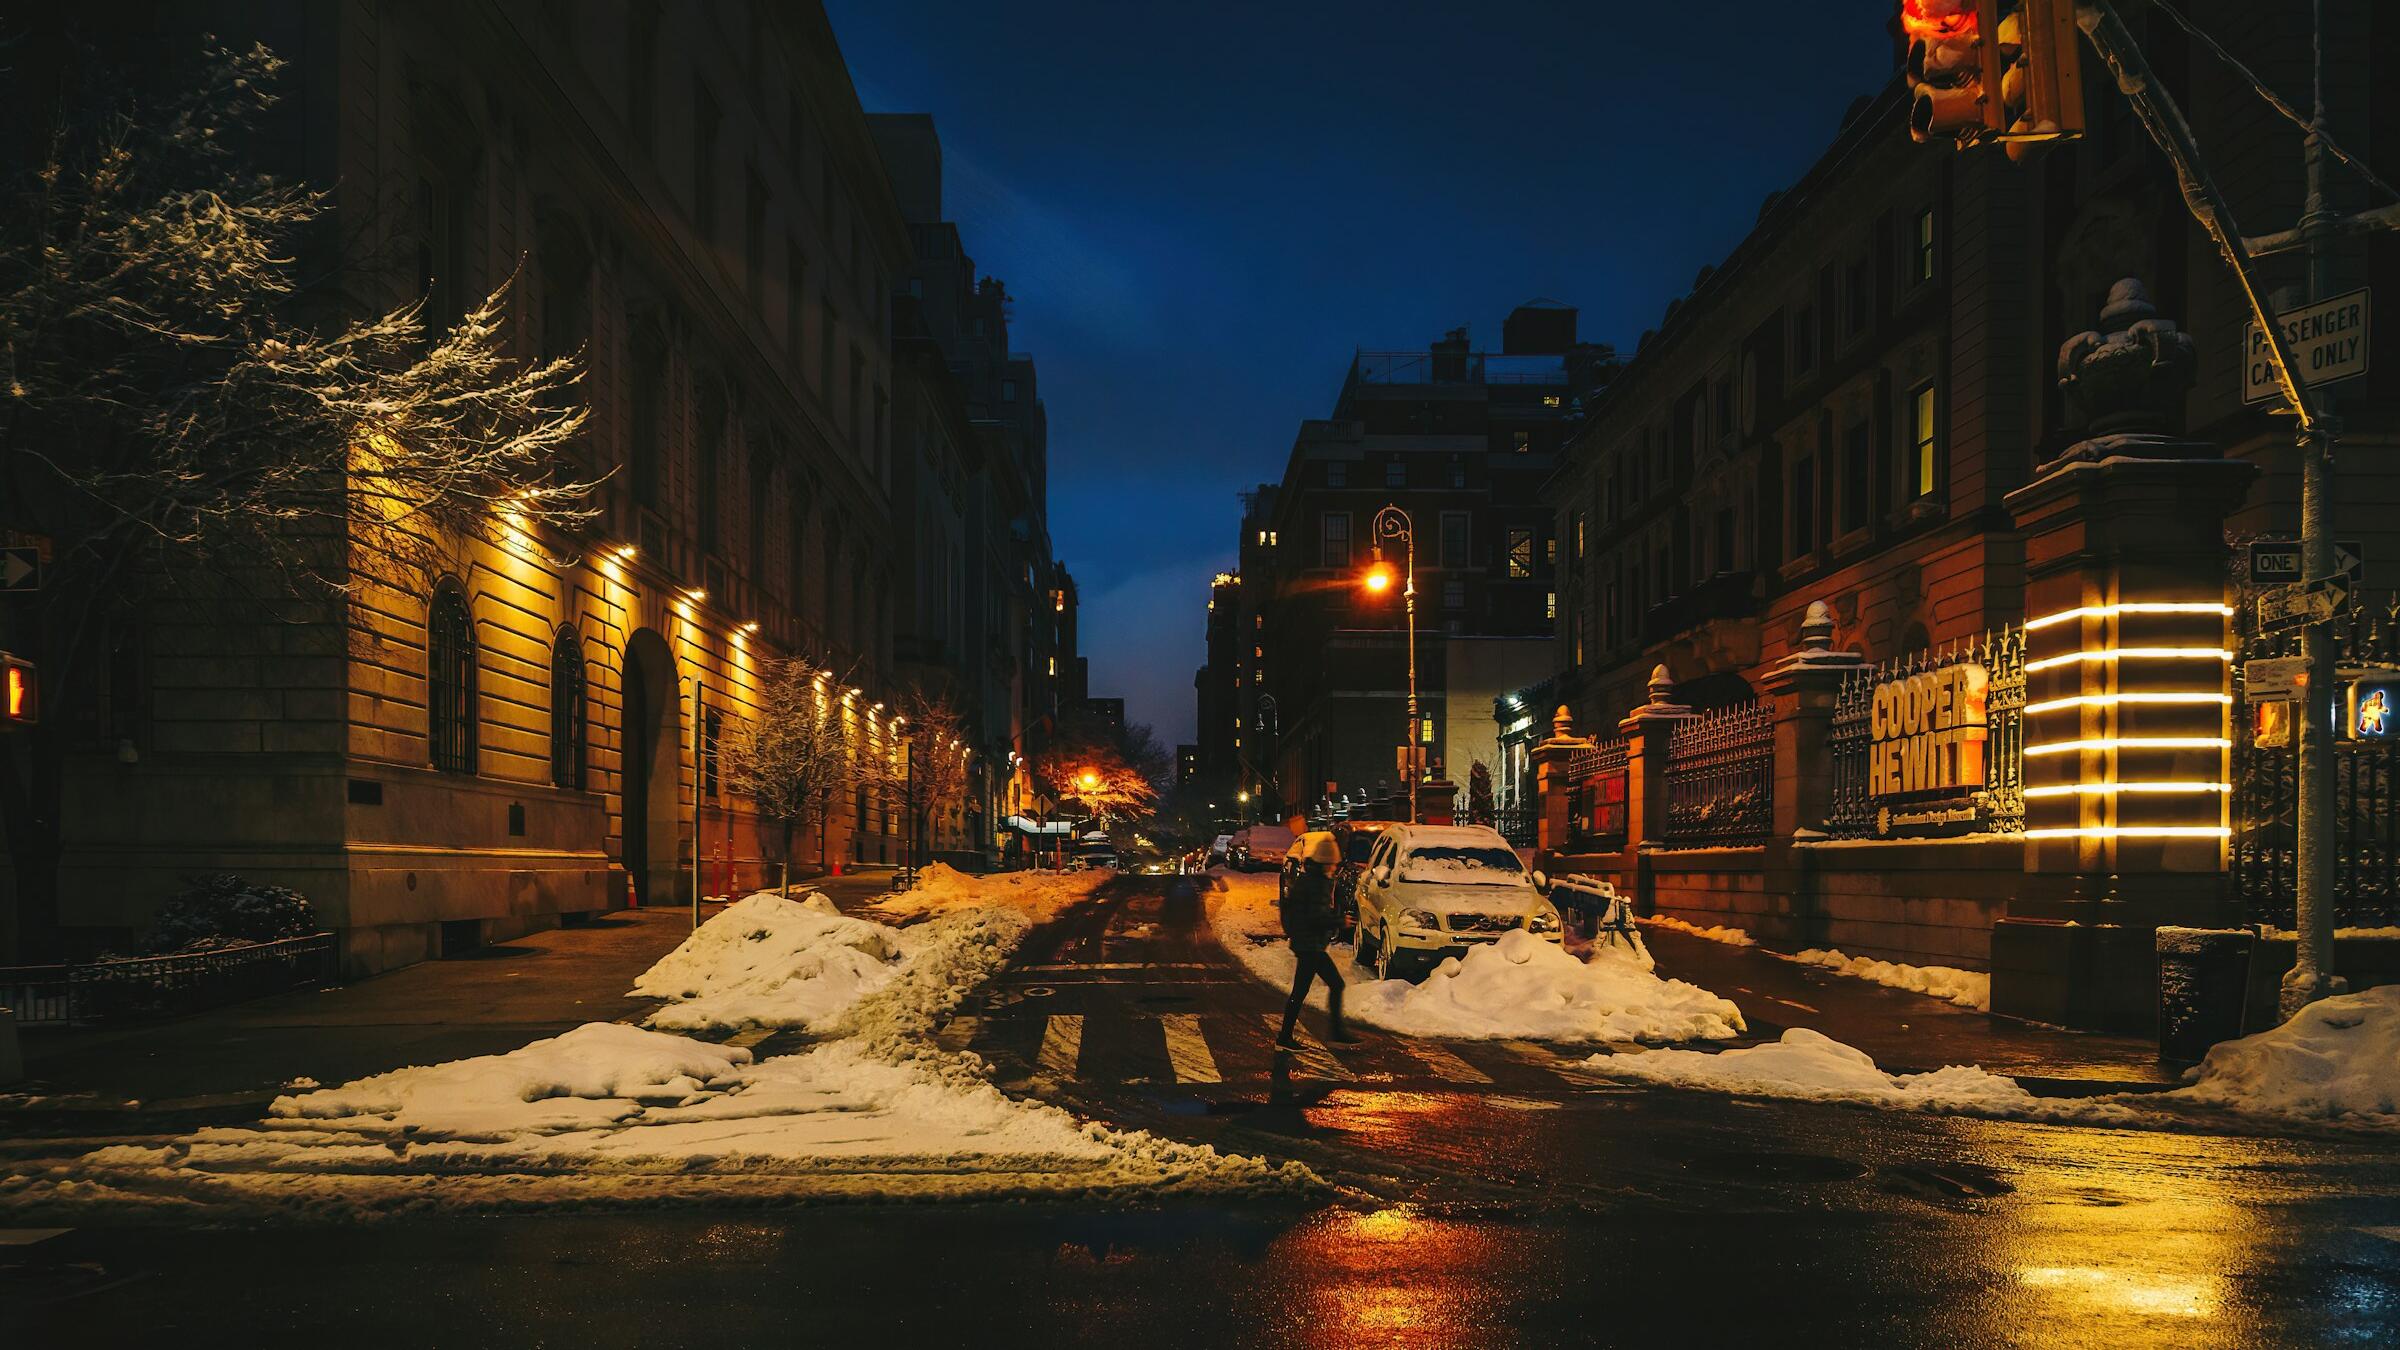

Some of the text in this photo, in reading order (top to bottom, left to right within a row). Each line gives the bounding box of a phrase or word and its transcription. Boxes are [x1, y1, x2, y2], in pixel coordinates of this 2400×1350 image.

[2252, 303, 2360, 355] PSENGER
[2312, 335, 2359, 370] ONLY
[2260, 555, 2293, 571] ONE
[1872, 664, 1972, 741] COOPER
[1869, 727, 1972, 796] HEWITT
